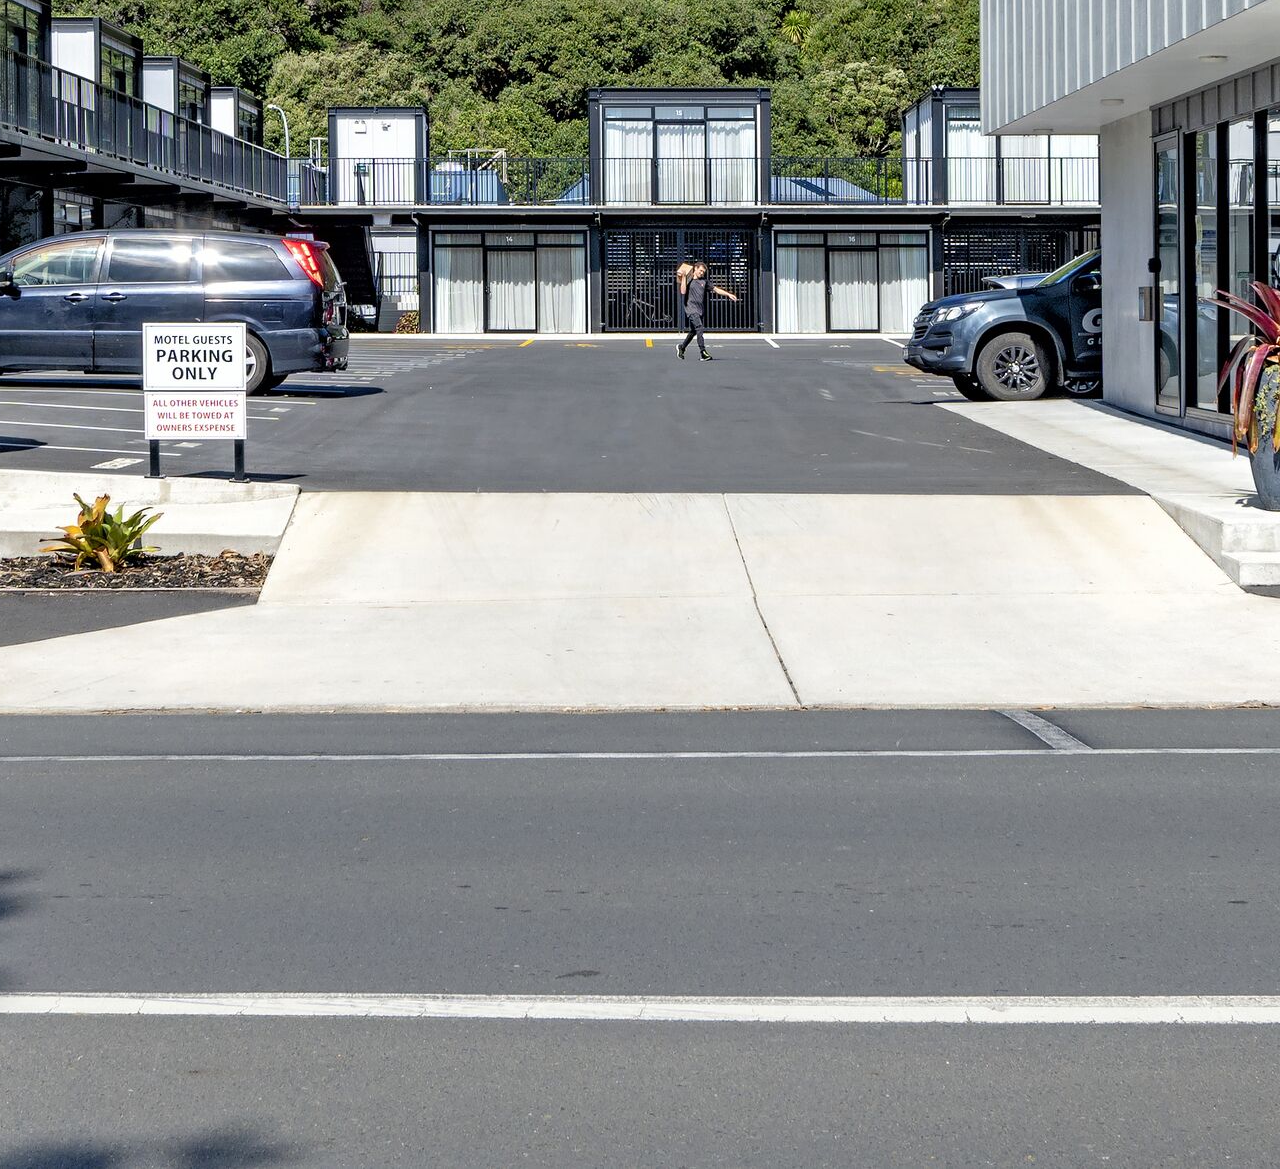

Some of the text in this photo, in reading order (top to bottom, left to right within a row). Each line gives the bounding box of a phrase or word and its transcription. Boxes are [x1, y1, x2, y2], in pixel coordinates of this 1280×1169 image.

[154, 335, 233, 344] MOTEL GUESTS
[156, 349, 233, 363] PARKING
[172, 366, 217, 380] ONLY
